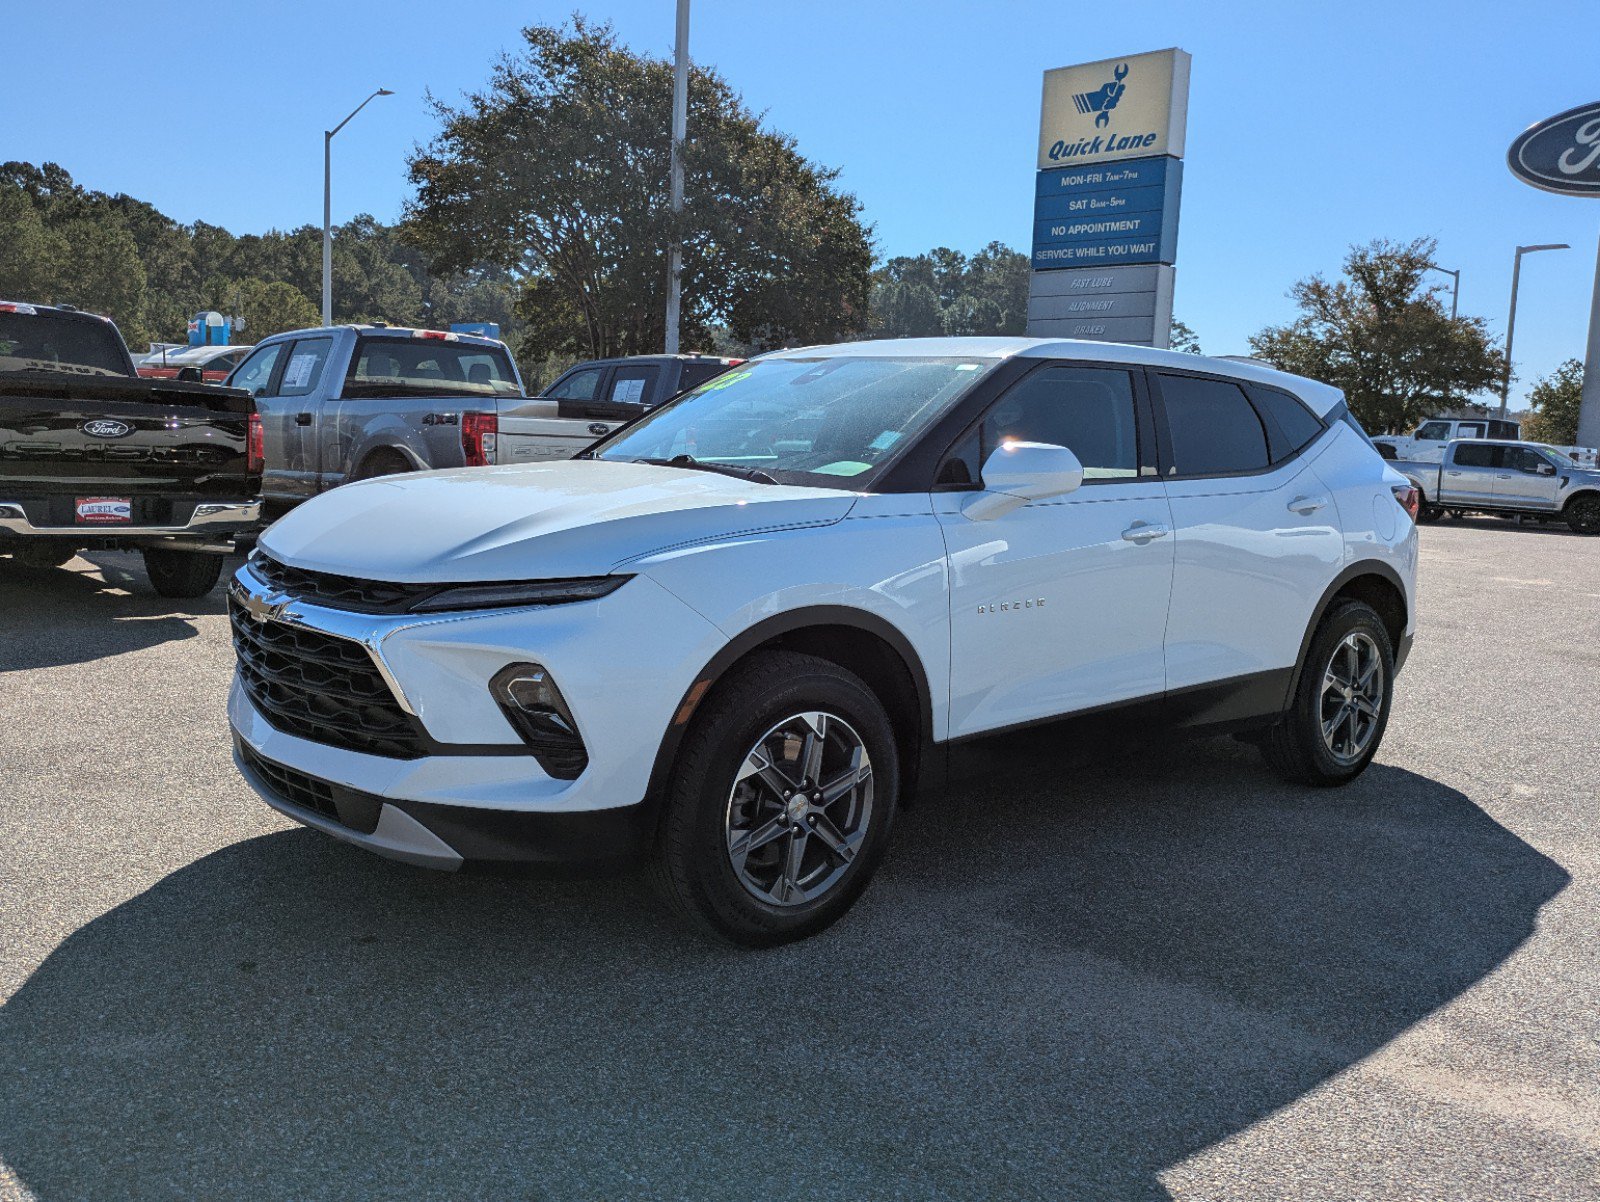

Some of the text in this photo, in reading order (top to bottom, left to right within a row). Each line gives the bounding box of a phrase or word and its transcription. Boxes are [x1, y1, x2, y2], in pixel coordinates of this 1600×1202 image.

[1049, 133, 1157, 161] Quick Lane
[1061, 173, 1103, 186] MON-FRI
[1069, 200, 1088, 211] SAT
[1051, 219, 1141, 236] NO APPOINTMENT
[1035, 242, 1156, 260] SERVICE WHILE YOU WAIT
[1070, 276, 1114, 289] FAST LUBE
[1068, 300, 1115, 312] ALIGNMENT
[1073, 324, 1106, 335] BRAKES
[91, 421, 121, 434] Ford
[81, 505, 114, 513] LAUREL
